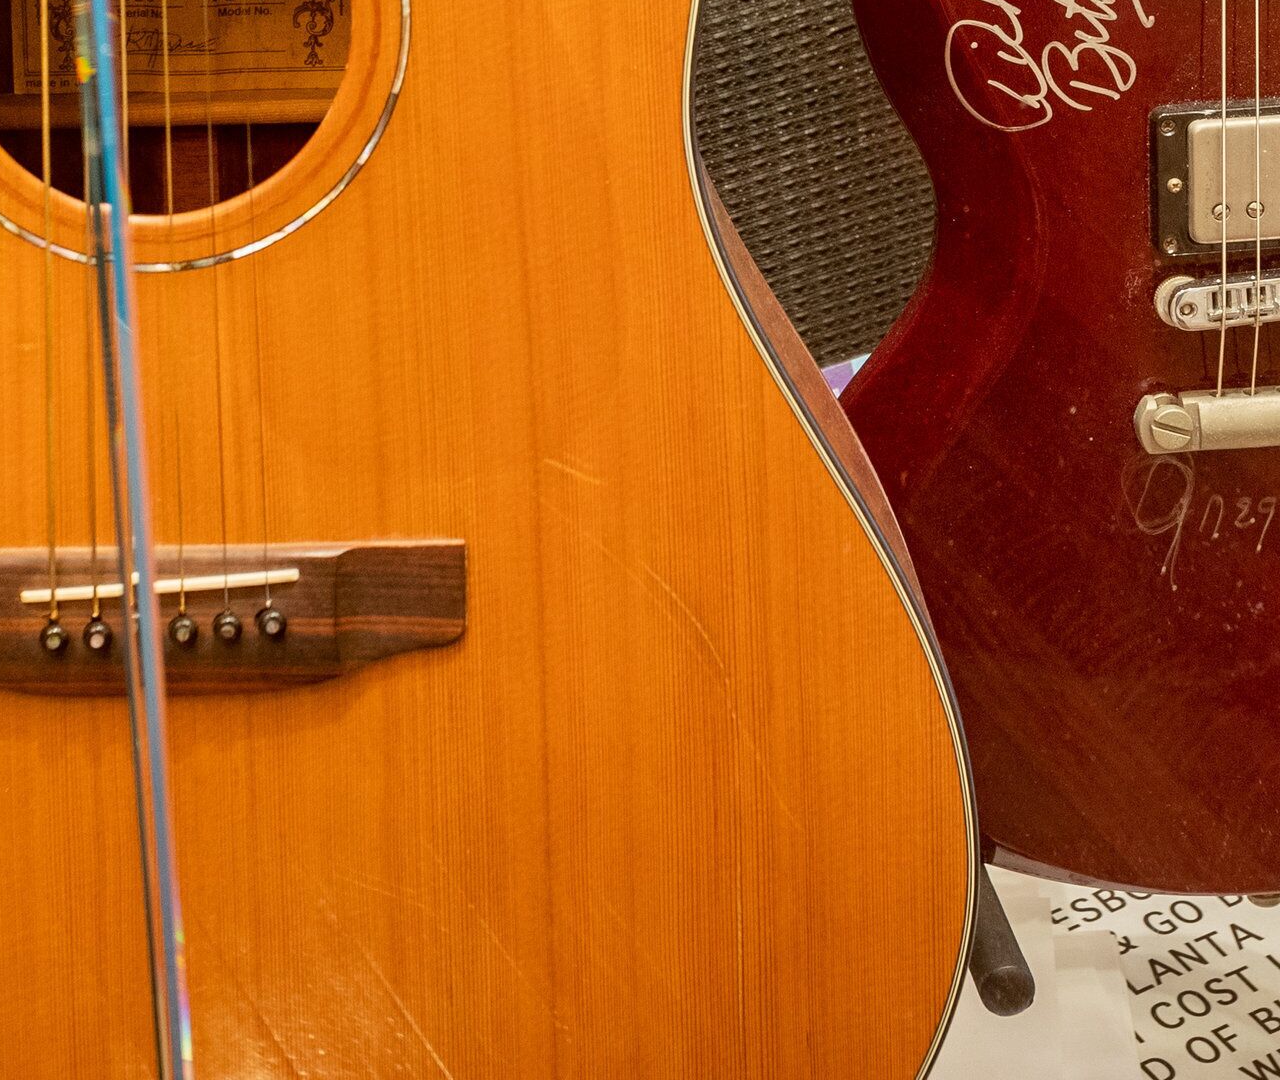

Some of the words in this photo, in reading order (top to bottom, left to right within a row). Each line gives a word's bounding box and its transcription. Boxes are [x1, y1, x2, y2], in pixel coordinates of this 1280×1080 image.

[217, 6, 251, 18] Model
[1143, 900, 1204, 935] GO
[1150, 965, 1259, 1029] COST
[1185, 1023, 1239, 1065] OF
